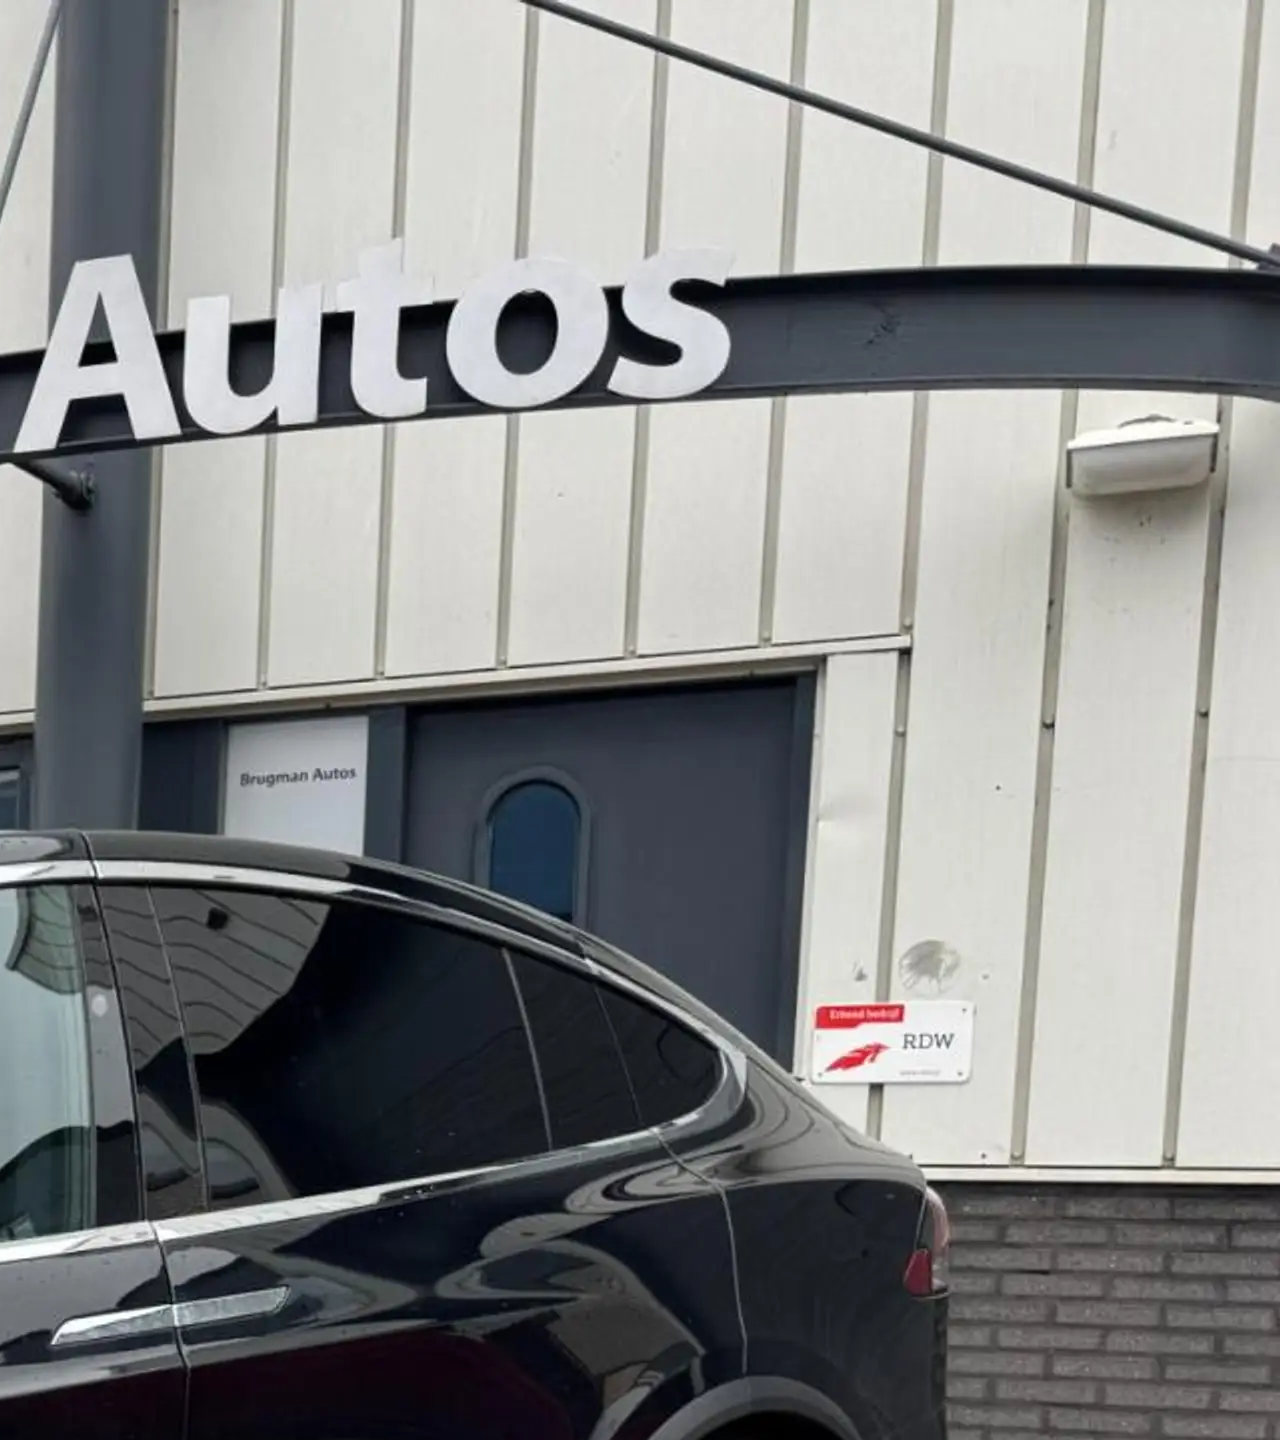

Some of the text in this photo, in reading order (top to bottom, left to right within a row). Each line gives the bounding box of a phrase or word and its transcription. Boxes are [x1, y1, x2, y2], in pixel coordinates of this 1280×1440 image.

[12, 238, 737, 454] Autos
[240, 767, 357, 788] Brugman Autos
[903, 1033, 954, 1050] RDW
